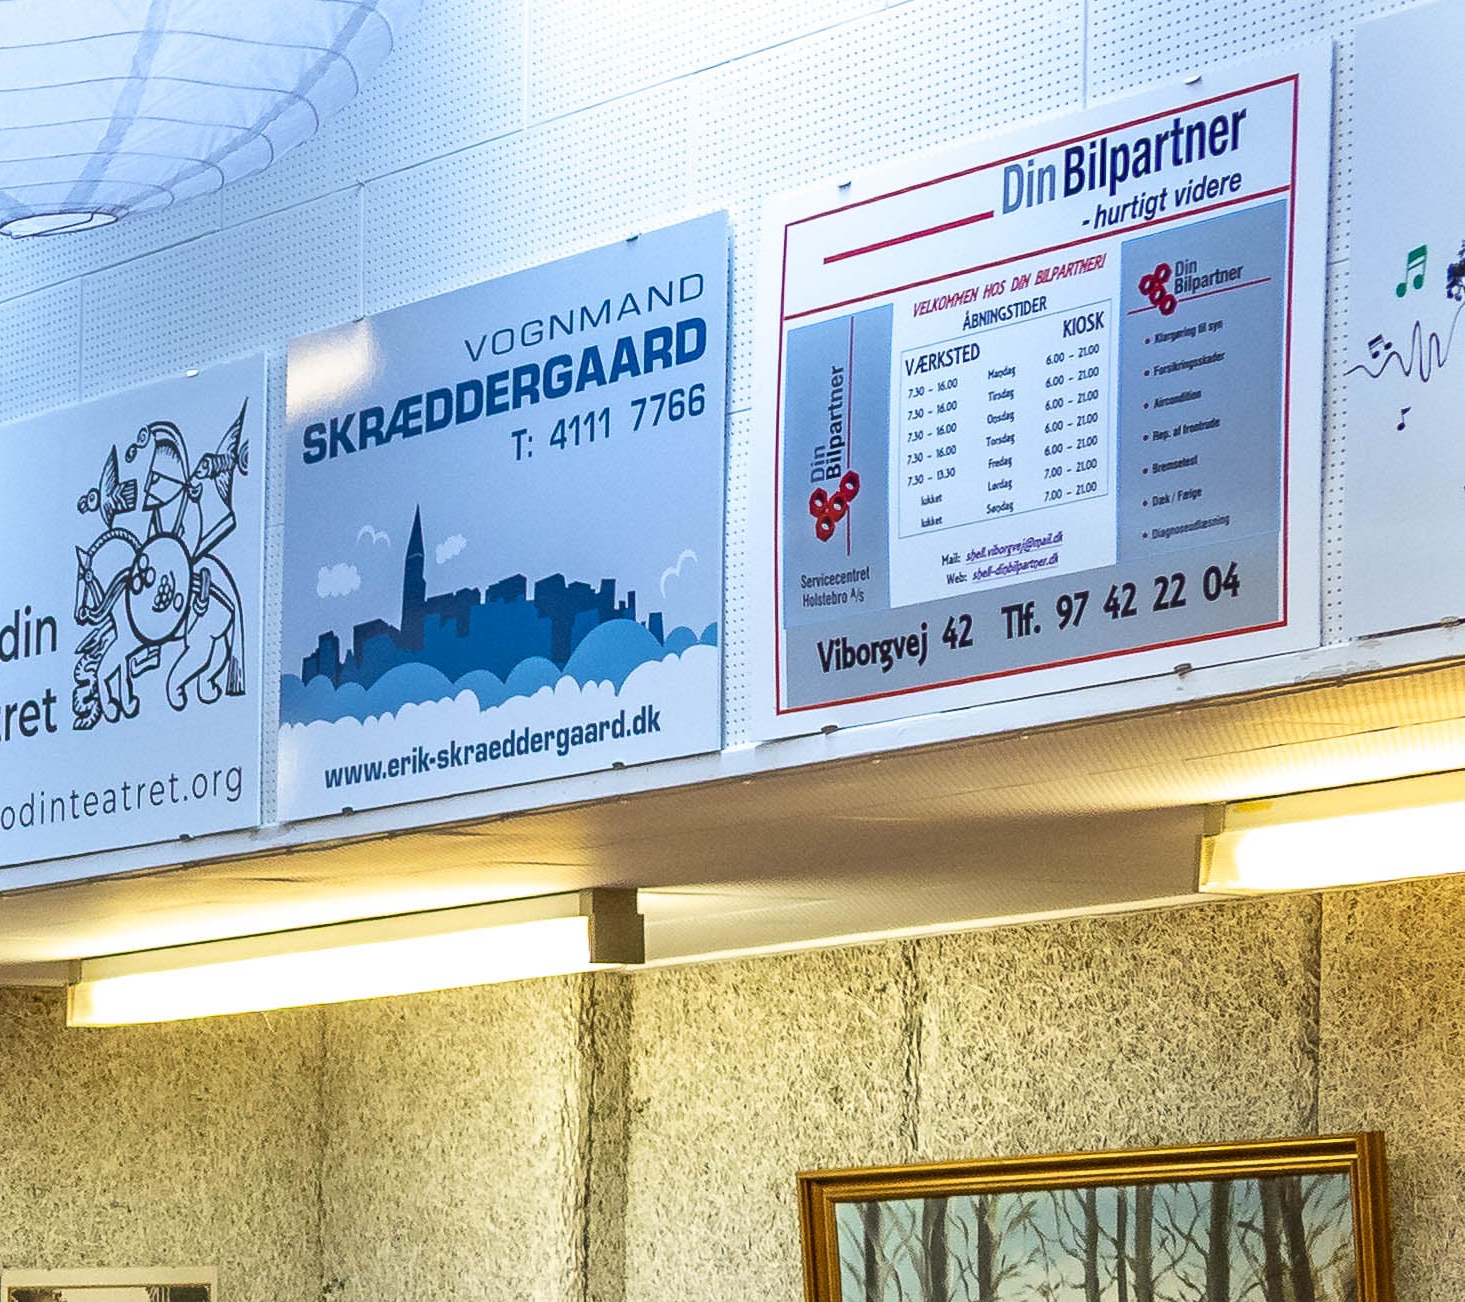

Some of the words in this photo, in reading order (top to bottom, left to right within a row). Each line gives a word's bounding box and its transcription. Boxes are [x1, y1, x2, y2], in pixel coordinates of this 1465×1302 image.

[1003, 159, 1056, 214] Din
[1063, 108, 1246, 197] Bilpartner
[1174, 172, 1242, 207] videre
[1174, 266, 1244, 295] Bilpartner
[1175, 259, 1197, 277] Din
[913, 287, 979, 317] VELKOMMEN
[983, 280, 1006, 299] HOS
[1011, 273, 1031, 292] DIN
[464, 273, 704, 363] VOGNMAND
[963, 296, 1047, 331] ÅBNINGSTIDER
[1063, 311, 1104, 338] KIOSK
[1208, 320, 1223, 332] syn
[905, 343, 980, 376] VÆRKSTED
[988, 365, 1016, 380] Mandag
[1046, 352, 1064, 366] 6.00
[1078, 344, 1100, 358] 21.00
[302, 317, 707, 466] SKRÆDDERGAARD
[1045, 375, 1064, 389] 6.00
[1077, 366, 1100, 381] 21.00
[1045, 397, 1064, 411] 6.00
[1077, 389, 1099, 404] 21.00
[1154, 390, 1202, 409] Aircondition
[511, 428, 534, 461] T:
[549, 407, 611, 450] 4111
[630, 383, 706, 432] 7766
[826, 366, 844, 480] Bilpartner
[1044, 420, 1064, 434] 6.00
[1077, 412, 1098, 427] 21.00
[810, 445, 826, 483] Din
[988, 456, 1012, 469] Fredag
[1044, 443, 1063, 456] 6.00
[1076, 435, 1098, 450] 21.00
[1152, 455, 1198, 474] Bremsetest
[988, 479, 1012, 492] Lørdag
[1044, 466, 1063, 480] 7.00
[1076, 458, 1098, 473] 21.00
[1044, 489, 1063, 502] 7.00
[1075, 481, 1097, 496] 21.00
[1177, 488, 1202, 501] Fælge
[942, 553, 961, 566] Mail:
[801, 566, 870, 589] Servicecentret
[946, 572, 967, 585] Web:
[802, 591, 848, 608] Holstebro
[817, 621, 929, 674] Viborgvej
[942, 613, 973, 650] 42
[1001, 601, 1041, 639] Tlf.
[1056, 591, 1090, 630] 97
[1103, 582, 1137, 620] 42
[1153, 572, 1186, 612] 22
[1203, 561, 1240, 601] 04
[324, 704, 661, 789] www.erik-skraeddergaard.dk
